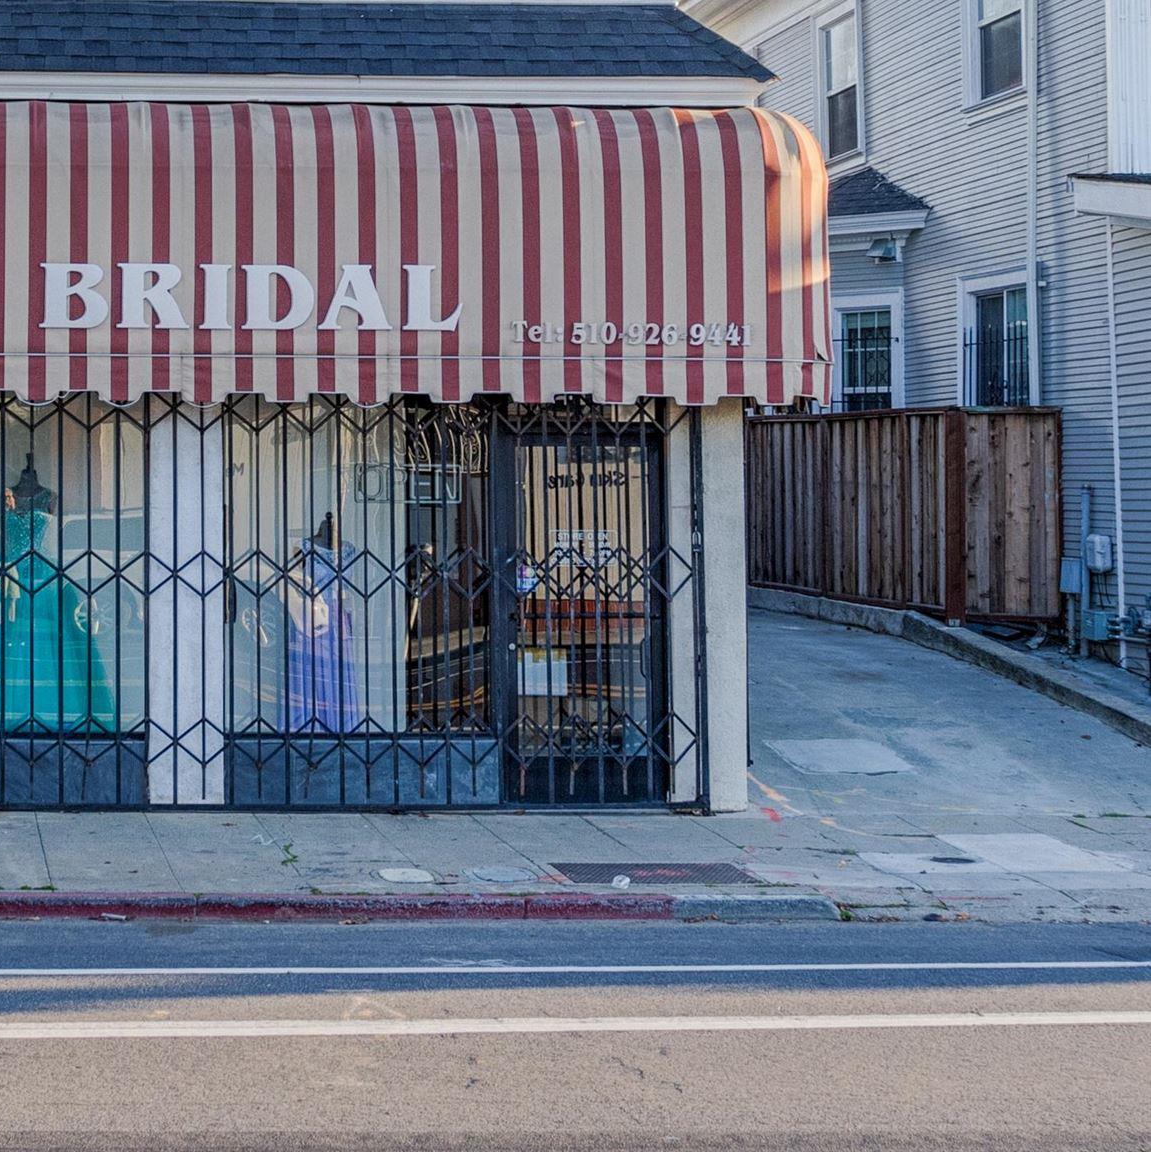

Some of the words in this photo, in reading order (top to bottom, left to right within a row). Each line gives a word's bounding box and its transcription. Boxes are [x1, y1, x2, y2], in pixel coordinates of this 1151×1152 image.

[38, 262, 463, 332] BRIDAL
[510, 320, 564, 344] Tel:
[570, 321, 752, 347] 510-926-9441
[357, 468, 457, 500] OPEN
[557, 532, 584, 541] STRE
[587, 532, 609, 541] OEN
